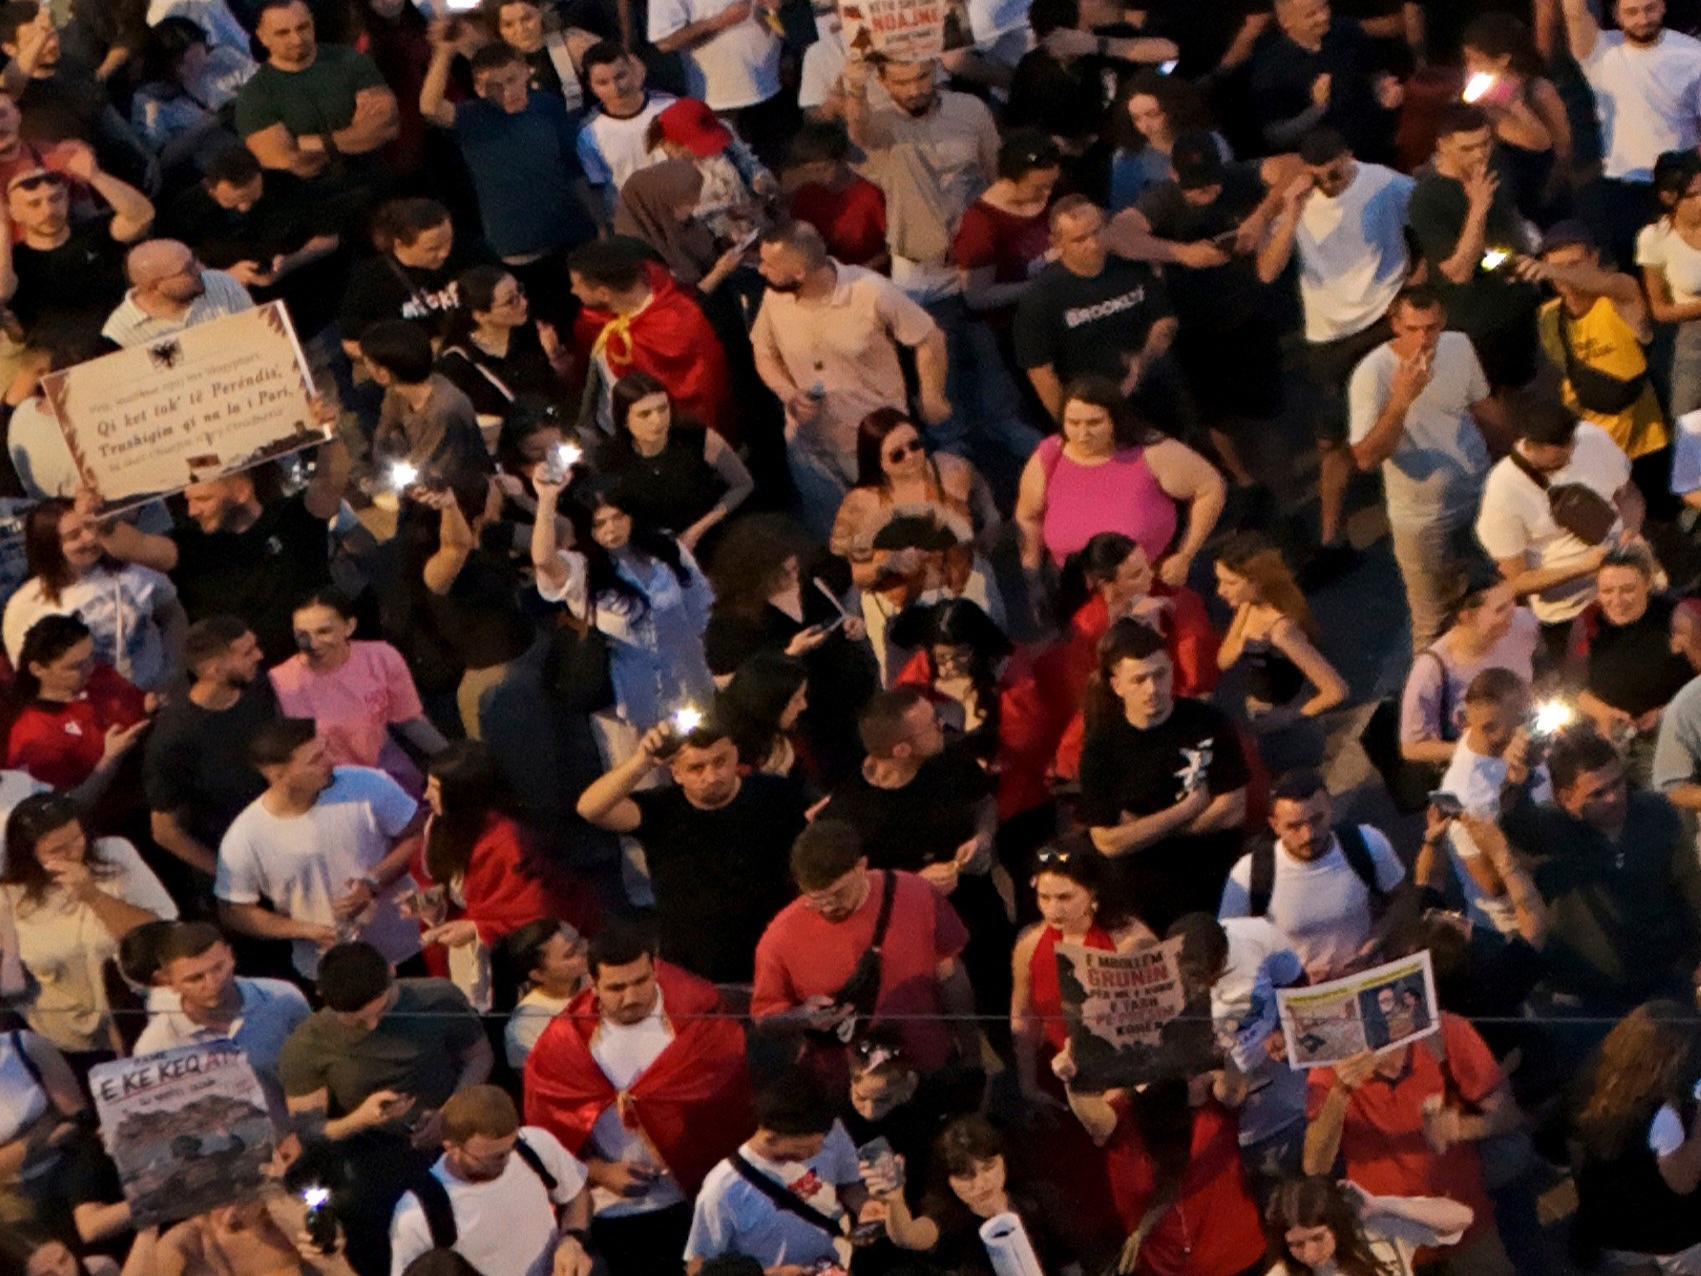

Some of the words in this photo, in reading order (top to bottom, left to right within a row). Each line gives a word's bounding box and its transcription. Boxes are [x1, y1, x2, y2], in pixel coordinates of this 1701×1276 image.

[100, 1078, 118, 1101] E
[122, 1067, 152, 1094] KE
[158, 1053, 202, 1082] KEQ
